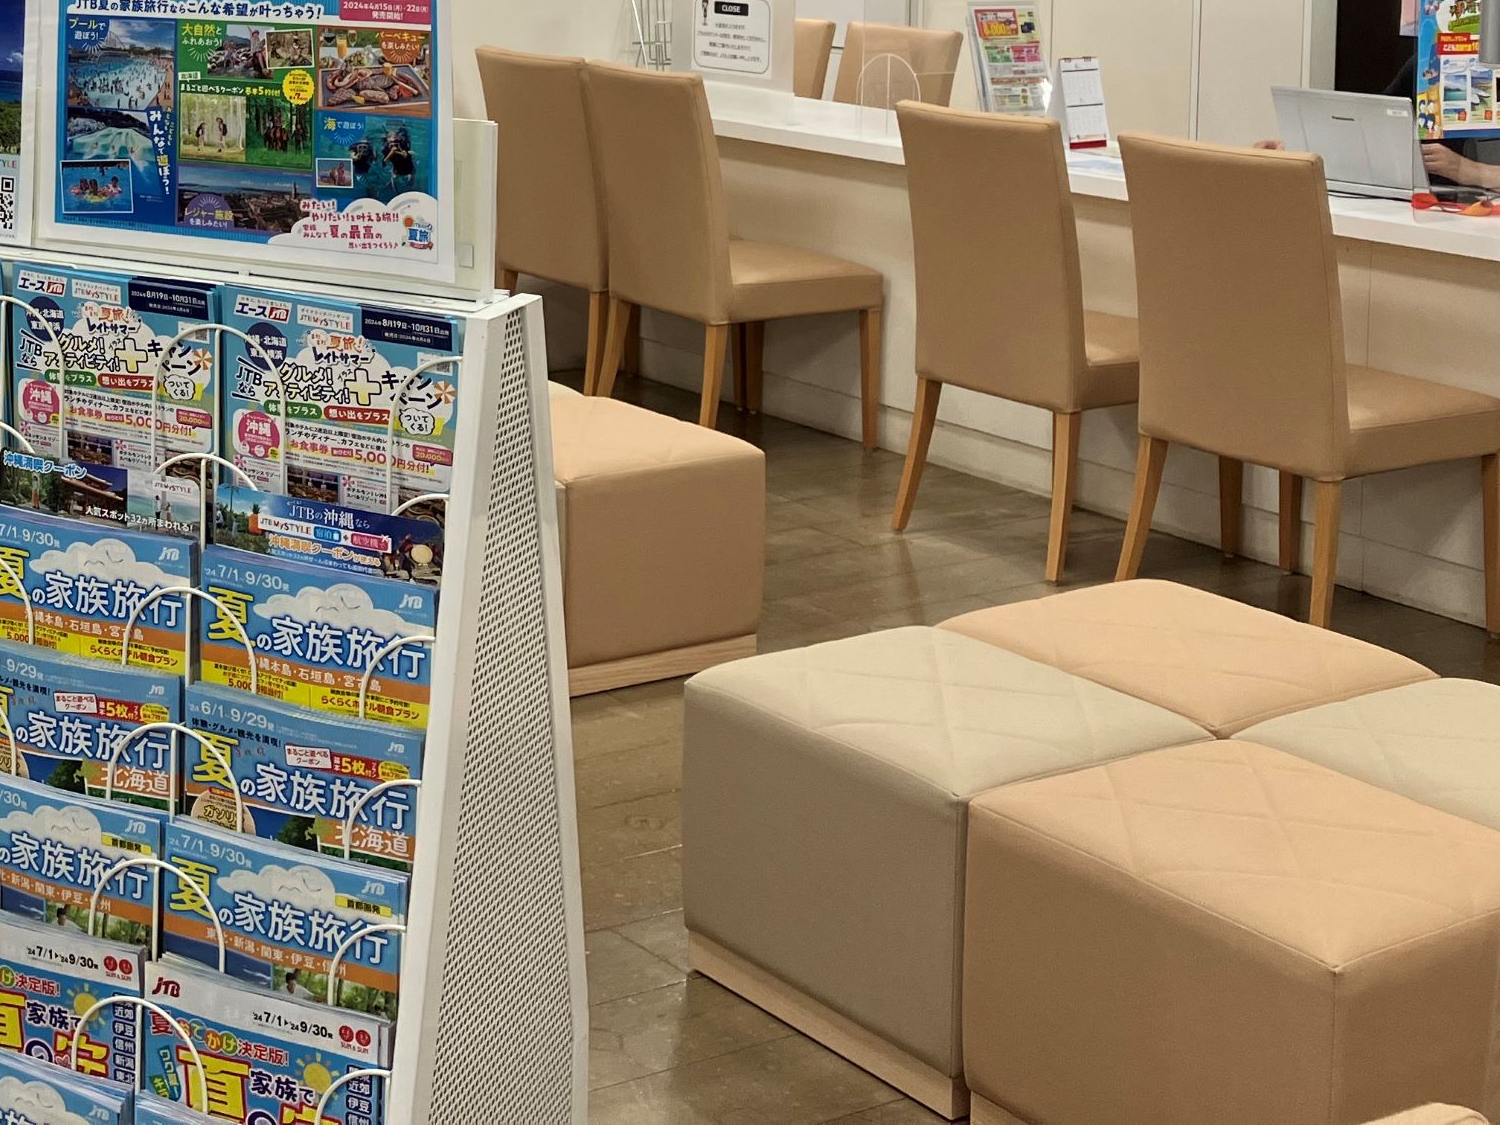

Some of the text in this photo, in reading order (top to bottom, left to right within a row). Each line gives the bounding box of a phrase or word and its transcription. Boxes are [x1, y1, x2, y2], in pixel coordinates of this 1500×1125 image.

[721, 3, 741, 14] CLOSE
[69, 18, 106, 32] プールで
[181, 23, 222, 37] 大自然と
[184, 207, 234, 221] レジャー施設
[19, 339, 42, 356] JTB
[236, 366, 262, 385] JTB
[281, 364, 334, 384] グルメ!
[237, 382, 255, 396] なら
[289, 503, 371, 530] JTBの沖縄なら
[208, 584, 425, 680] 夏の家族旅行
[101, 764, 171, 794] 北海道
[336, 824, 411, 858] 北海道
[152, 977, 181, 998] JTB
[114, 1022, 134, 1037] 伊豆
[114, 1038, 135, 1054] 信州
[348, 1097, 370, 1113] 伊豆
